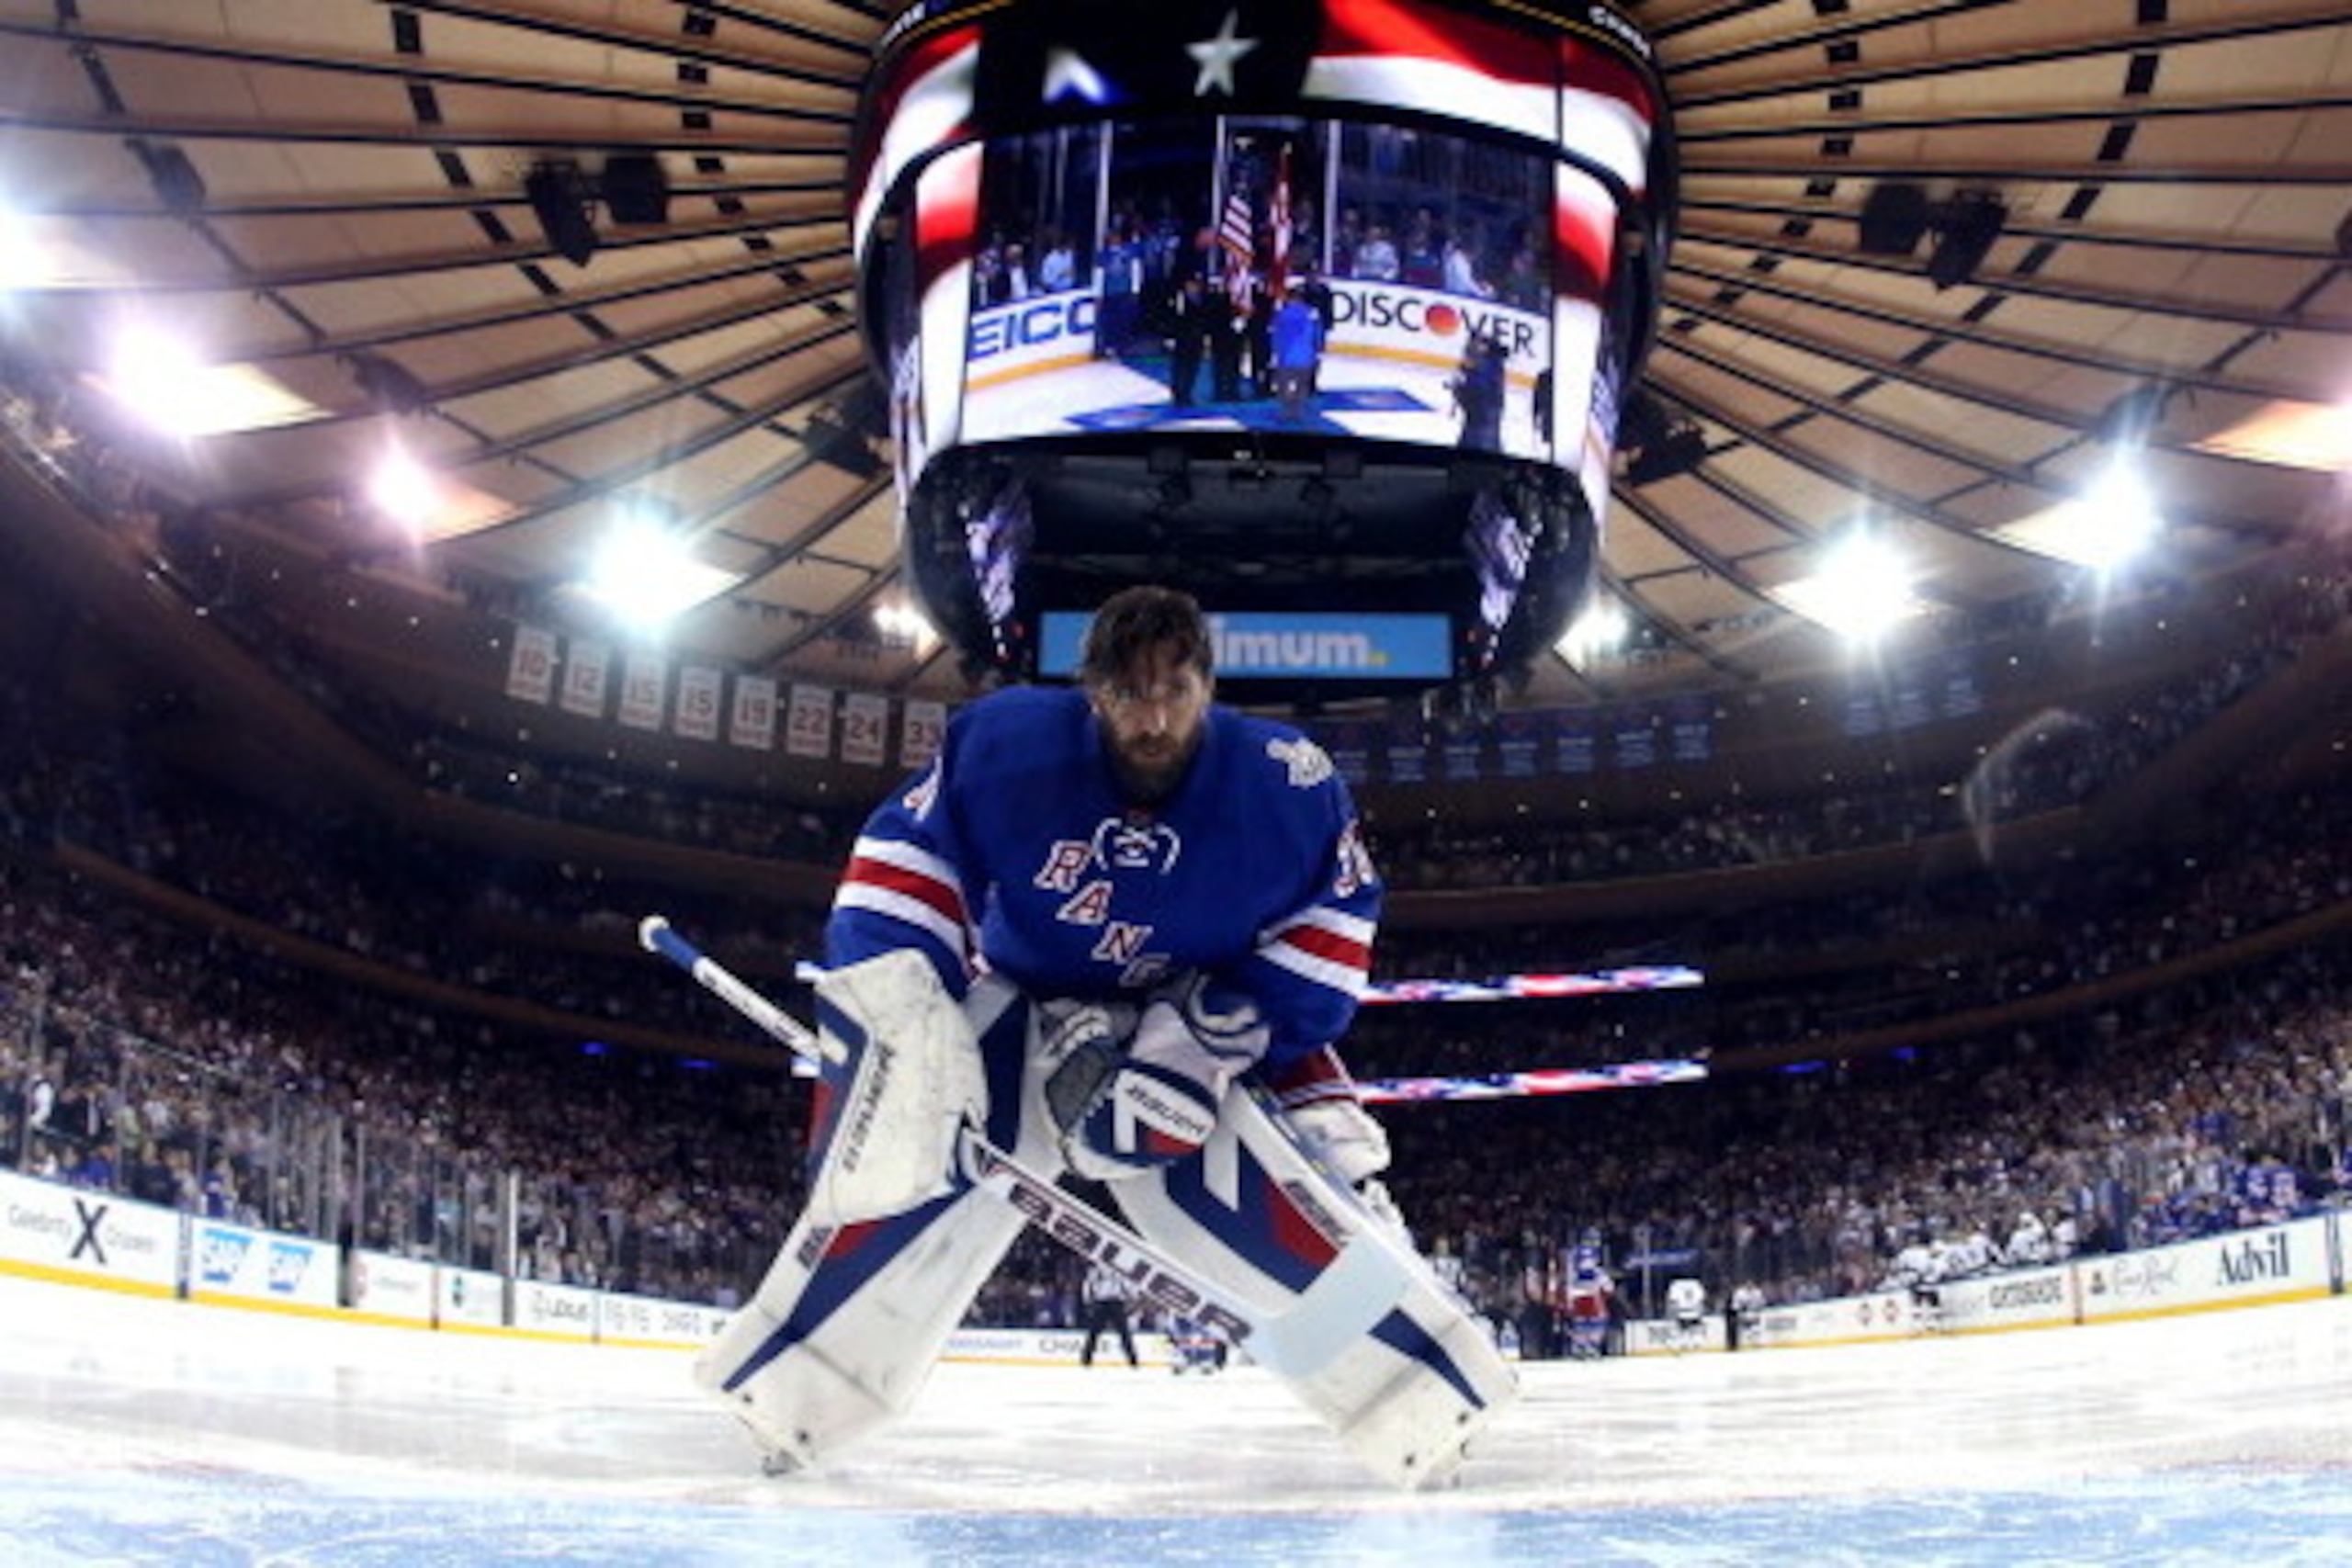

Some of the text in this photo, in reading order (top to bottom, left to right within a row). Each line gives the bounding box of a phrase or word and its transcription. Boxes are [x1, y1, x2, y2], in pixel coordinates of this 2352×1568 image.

[1331, 290, 1536, 358] DISCOVER
[792, 705, 826, 732] 22
[1009, 1181, 1254, 1347] BAUER
[2217, 1232, 2290, 1287] Advil
[1038, 1337, 1111, 1354] CHAE
